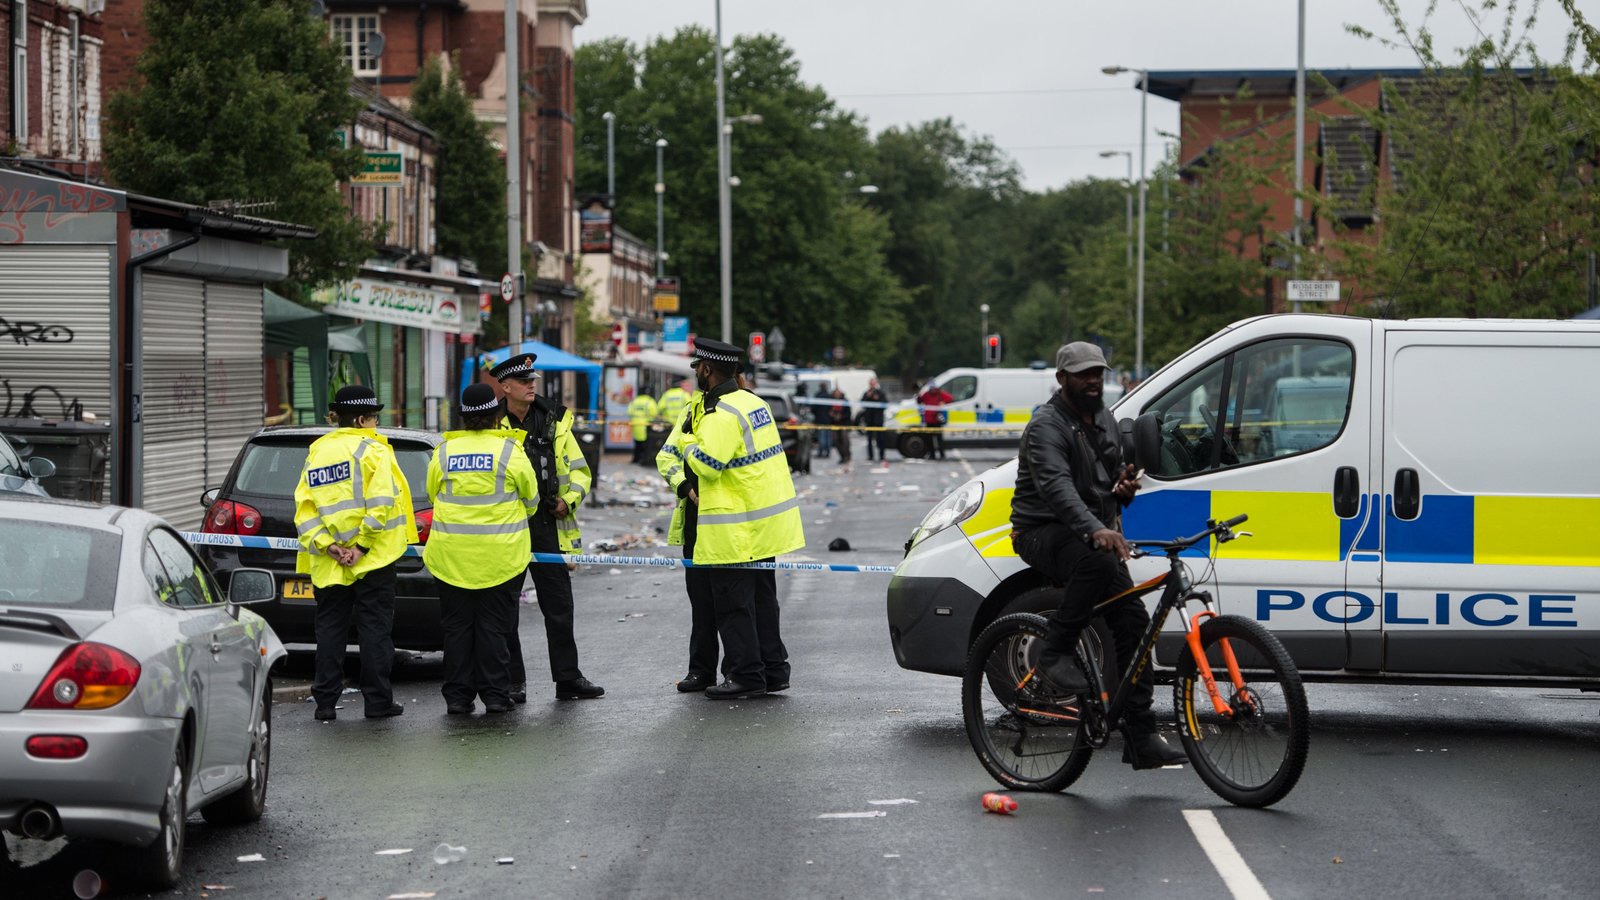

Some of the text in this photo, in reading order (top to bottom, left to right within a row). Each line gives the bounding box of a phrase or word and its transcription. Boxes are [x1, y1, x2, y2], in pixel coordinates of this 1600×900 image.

[368, 284, 434, 314] FRESH
[449, 455, 492, 470] POLICE
[309, 463, 349, 485] POLICE
[190, 533, 206, 543] NOT
[208, 534, 235, 544] CROSS
[276, 538, 299, 549] POLIC
[570, 555, 676, 566] POLICE LINE DO NOT CROSS
[291, 580, 312, 596] AF
[1256, 589, 1578, 627] POLICE
[1177, 676, 1190, 737] KENDA
